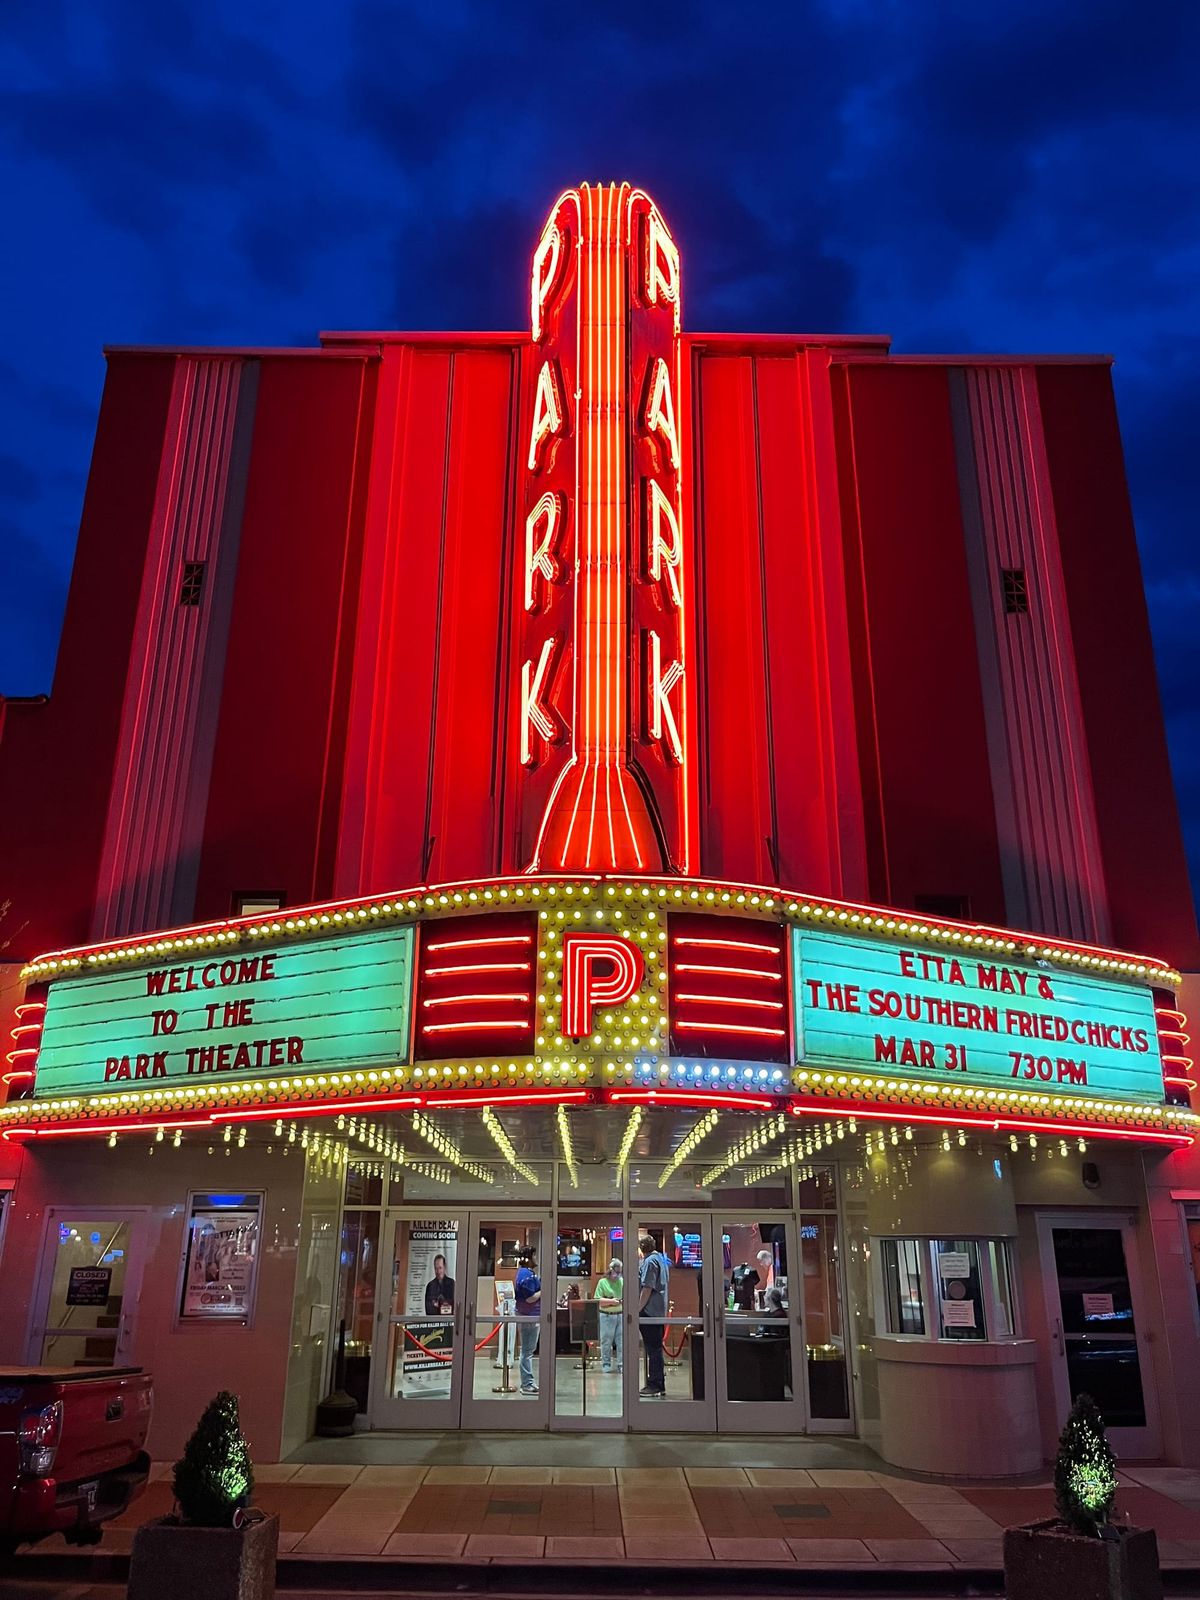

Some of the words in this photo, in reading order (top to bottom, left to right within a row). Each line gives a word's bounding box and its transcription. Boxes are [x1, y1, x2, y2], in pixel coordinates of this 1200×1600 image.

[521, 224, 562, 765] PARK
[648, 211, 684, 765] PARK
[146, 953, 278, 996] WELCOME
[561, 931, 645, 1038] P
[899, 950, 966, 986] ETTA
[977, 963, 1029, 995] MAY
[1036, 974, 1056, 1001] &
[151, 1010, 179, 1037] TO
[205, 998, 256, 1030] THE
[806, 979, 861, 1013] THE
[867, 988, 999, 1033] SOUTHERN
[1005, 1008, 1069, 1042] FRIED
[1071, 1019, 1150, 1055] CHICKS
[104, 1050, 169, 1082] PARK
[186, 1036, 305, 1074] THEATER
[874, 1033, 936, 1069] MAR
[944, 1043, 968, 1071] 31
[412, 1231, 438, 1239] COMING
[438, 1231, 456, 1239] SOON
[75, 1271, 106, 1279] CLOSED
